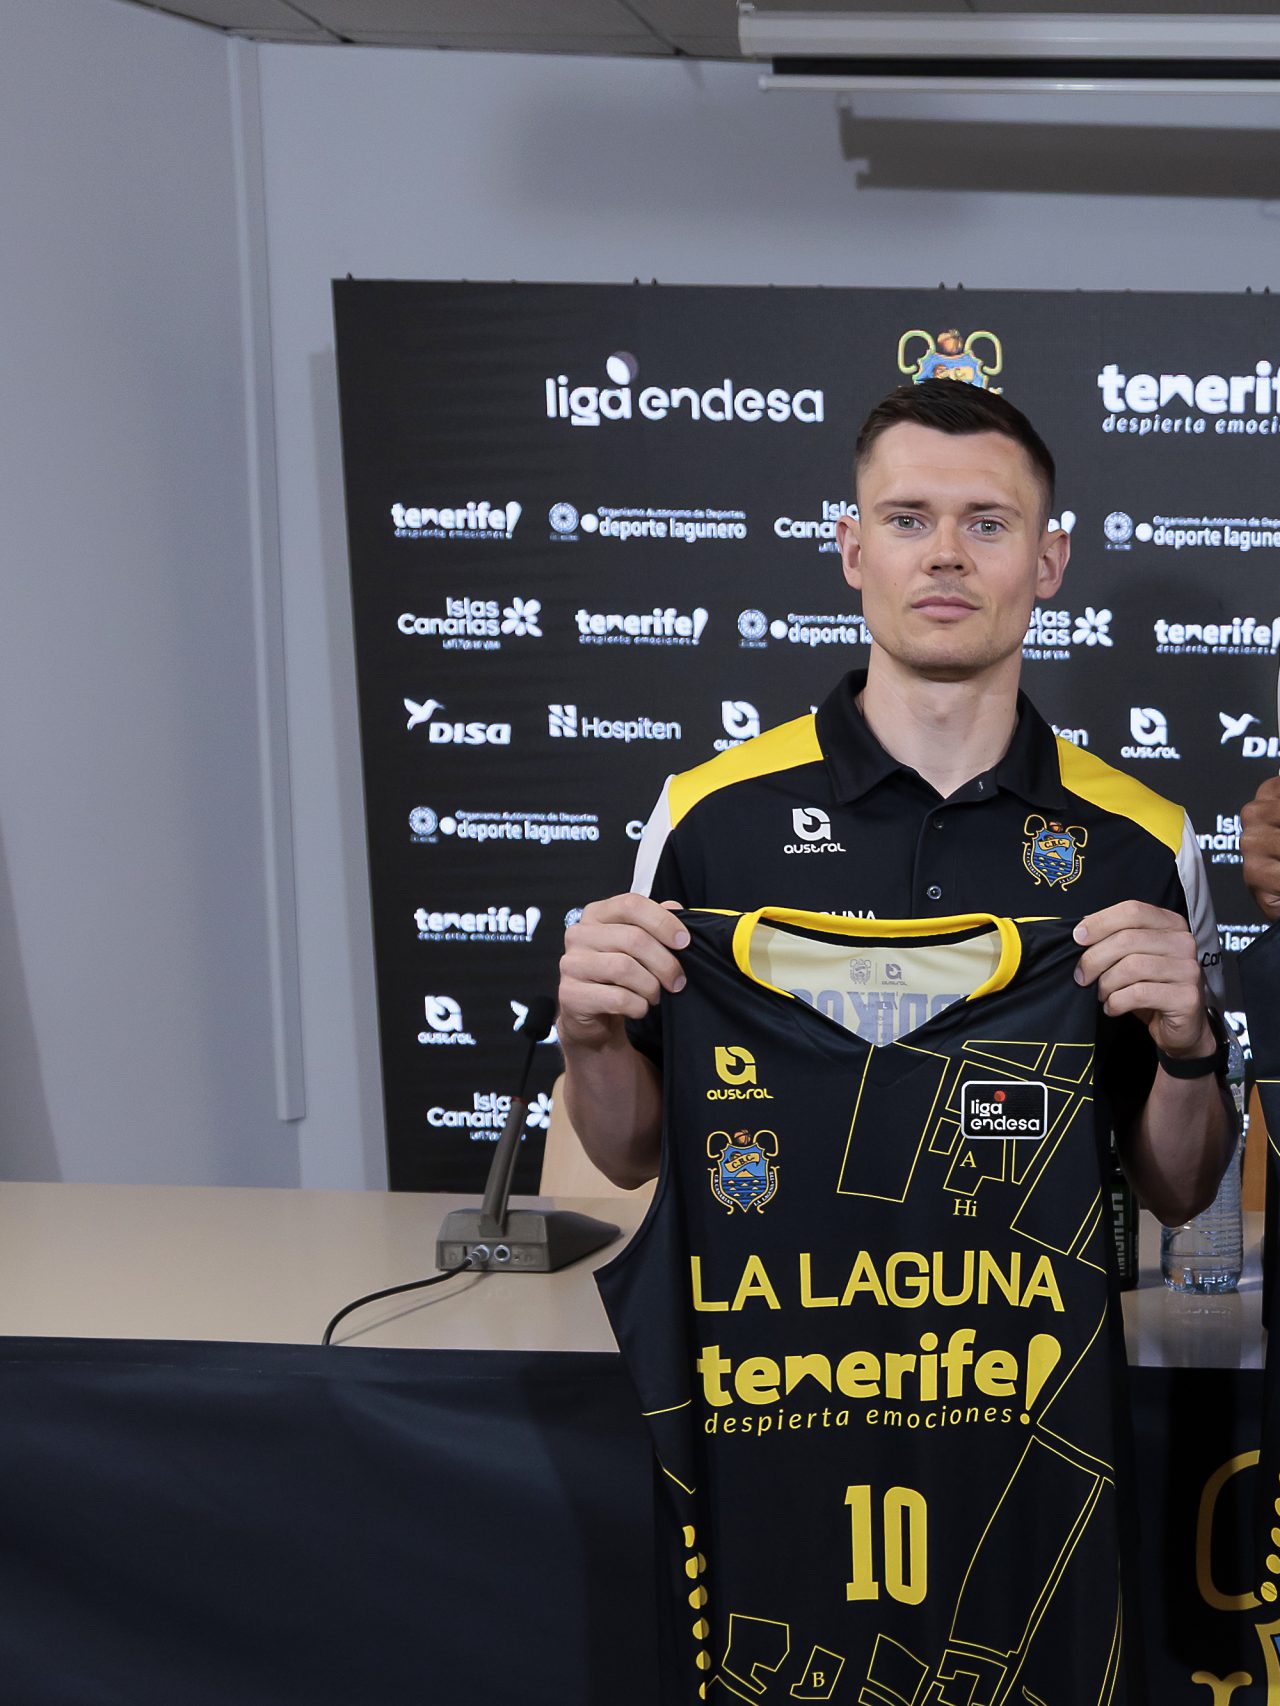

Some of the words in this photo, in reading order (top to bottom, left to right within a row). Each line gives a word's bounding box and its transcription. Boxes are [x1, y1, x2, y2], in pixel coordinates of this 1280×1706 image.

[544, 376, 632, 426] liga
[639, 379, 824, 422] endesa
[1102, 413, 1205, 435] despierta
[391, 501, 522, 539] tenerife!
[822, 500, 859, 521] Isla
[599, 515, 668, 540] deporte
[669, 515, 746, 542] lagunero
[773, 517, 837, 539] Cana
[1152, 525, 1222, 549] deporte
[446, 597, 500, 618] Islas
[1029, 607, 1071, 629] slas
[397, 613, 500, 636] Canarias
[575, 608, 708, 645] tenerife!
[786, 621, 858, 647] deporte
[427, 719, 511, 744] DISA
[582, 717, 681, 742] Hospiten
[1241, 735, 1280, 759] DI
[455, 820, 522, 842] deporte
[524, 820, 599, 844] lagunero
[1216, 814, 1242, 834] Isl
[784, 843, 846, 854] austral
[414, 907, 540, 942] tenerife!
[473, 1092, 512, 1112] Isla
[706, 1088, 774, 1101] austral
[427, 1107, 508, 1128] Canari
[970, 1099, 1003, 1118] liga
[970, 1114, 1041, 1132] endesa
[959, 1150, 977, 1169] A
[952, 1199, 978, 1217] Hi
[690, 1254, 781, 1311] LA
[799, 1250, 1065, 1312] LAGUNA
[697, 1328, 1062, 1425] tenerife!
[704, 1408, 850, 1436] despierta
[865, 1404, 1013, 1429] emociones
[844, 1484, 928, 1606] 10
[812, 1671, 826, 1687] B
